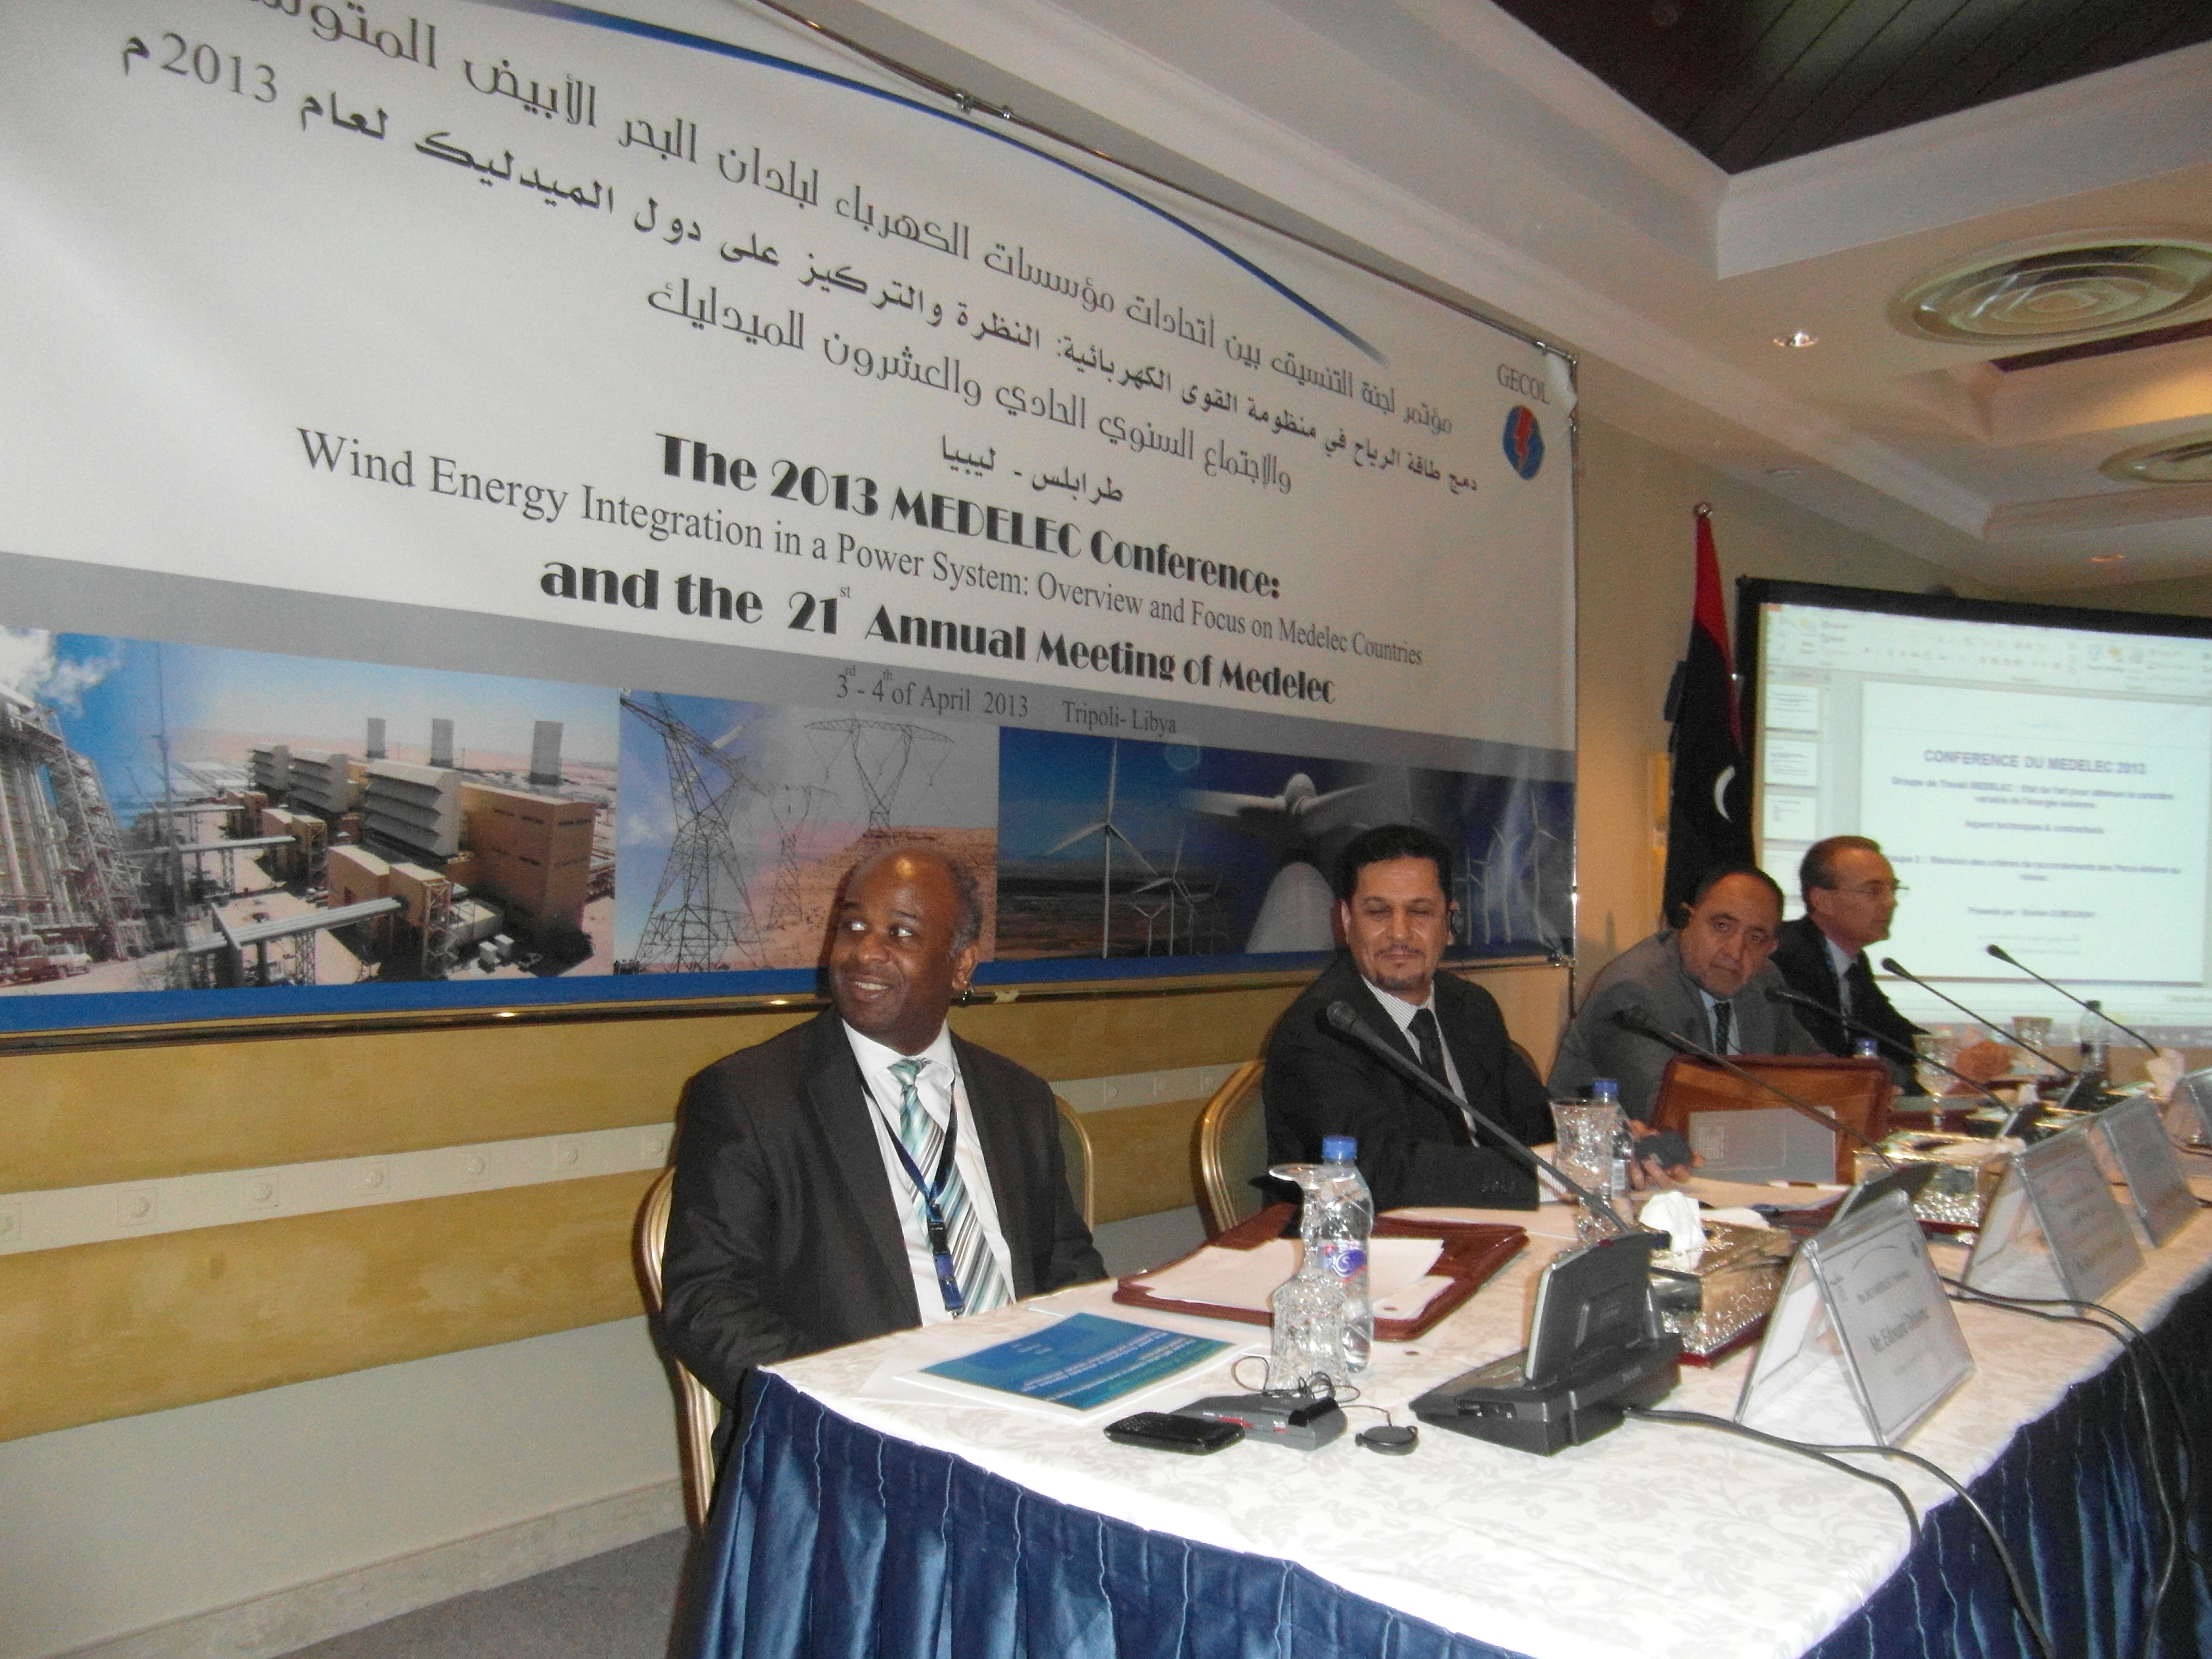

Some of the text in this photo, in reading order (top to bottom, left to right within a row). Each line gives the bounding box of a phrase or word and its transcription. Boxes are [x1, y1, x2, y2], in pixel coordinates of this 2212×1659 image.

[300, 91, 389, 141] لعام
[464, 59, 597, 127] الأبيض
[618, 116, 697, 163] البحر
[415, 131, 613, 214] الميدليك
[634, 197, 702, 245] دول
[836, 186, 970, 260] الكهرباء
[720, 233, 779, 267] على
[800, 252, 943, 327] والتركيز
[984, 243, 1115, 312] مؤسسات
[957, 302, 1040, 350] النظرة
[1126, 295, 1215, 348] اتحادات
[1057, 337, 1172, 390] الكهربائية:
[1225, 335, 1261, 369] بين
[1271, 352, 1353, 398] التنسيق
[647, 278, 1292, 495] والاجتماع السنوي الحادي والعشرون للميدليك
[1181, 384, 1237, 413] القوى
[1361, 381, 1395, 415] لجنة
[1497, 364, 1550, 405] GECOL
[1248, 396, 1317, 438] منظومة
[1404, 403, 1452, 435] مؤتمر
[942, 434, 997, 478] ليبيا
[1325, 427, 1347, 457] في
[1355, 438, 1400, 470] الرياح
[1031, 466, 1124, 506] طرابلس
[1407, 452, 1441, 480] طاقة
[1448, 473, 1477, 495] دمج
[655, 432, 1281, 599] The 2013 MEDELEC Conference:
[296, 427, 1424, 666] Wind Energy Integration in a Power System: Overview and Focus on Medelec Countries
[540, 560, 659, 611] and
[674, 573, 764, 624] the
[864, 604, 1027, 661] Annual
[1036, 630, 1176, 682] Meeting
[1183, 655, 1214, 686] of
[1220, 659, 1336, 705] Medelec
[893, 682, 917, 706] of
[920, 685, 970, 716] April
[983, 691, 1028, 718] 2013
[1132, 708, 1176, 737] Libya
[1923, 749, 2020, 768] CONFERENCE
[2025, 756, 2044, 769] DU
[2048, 757, 2113, 773] MEDELEC
